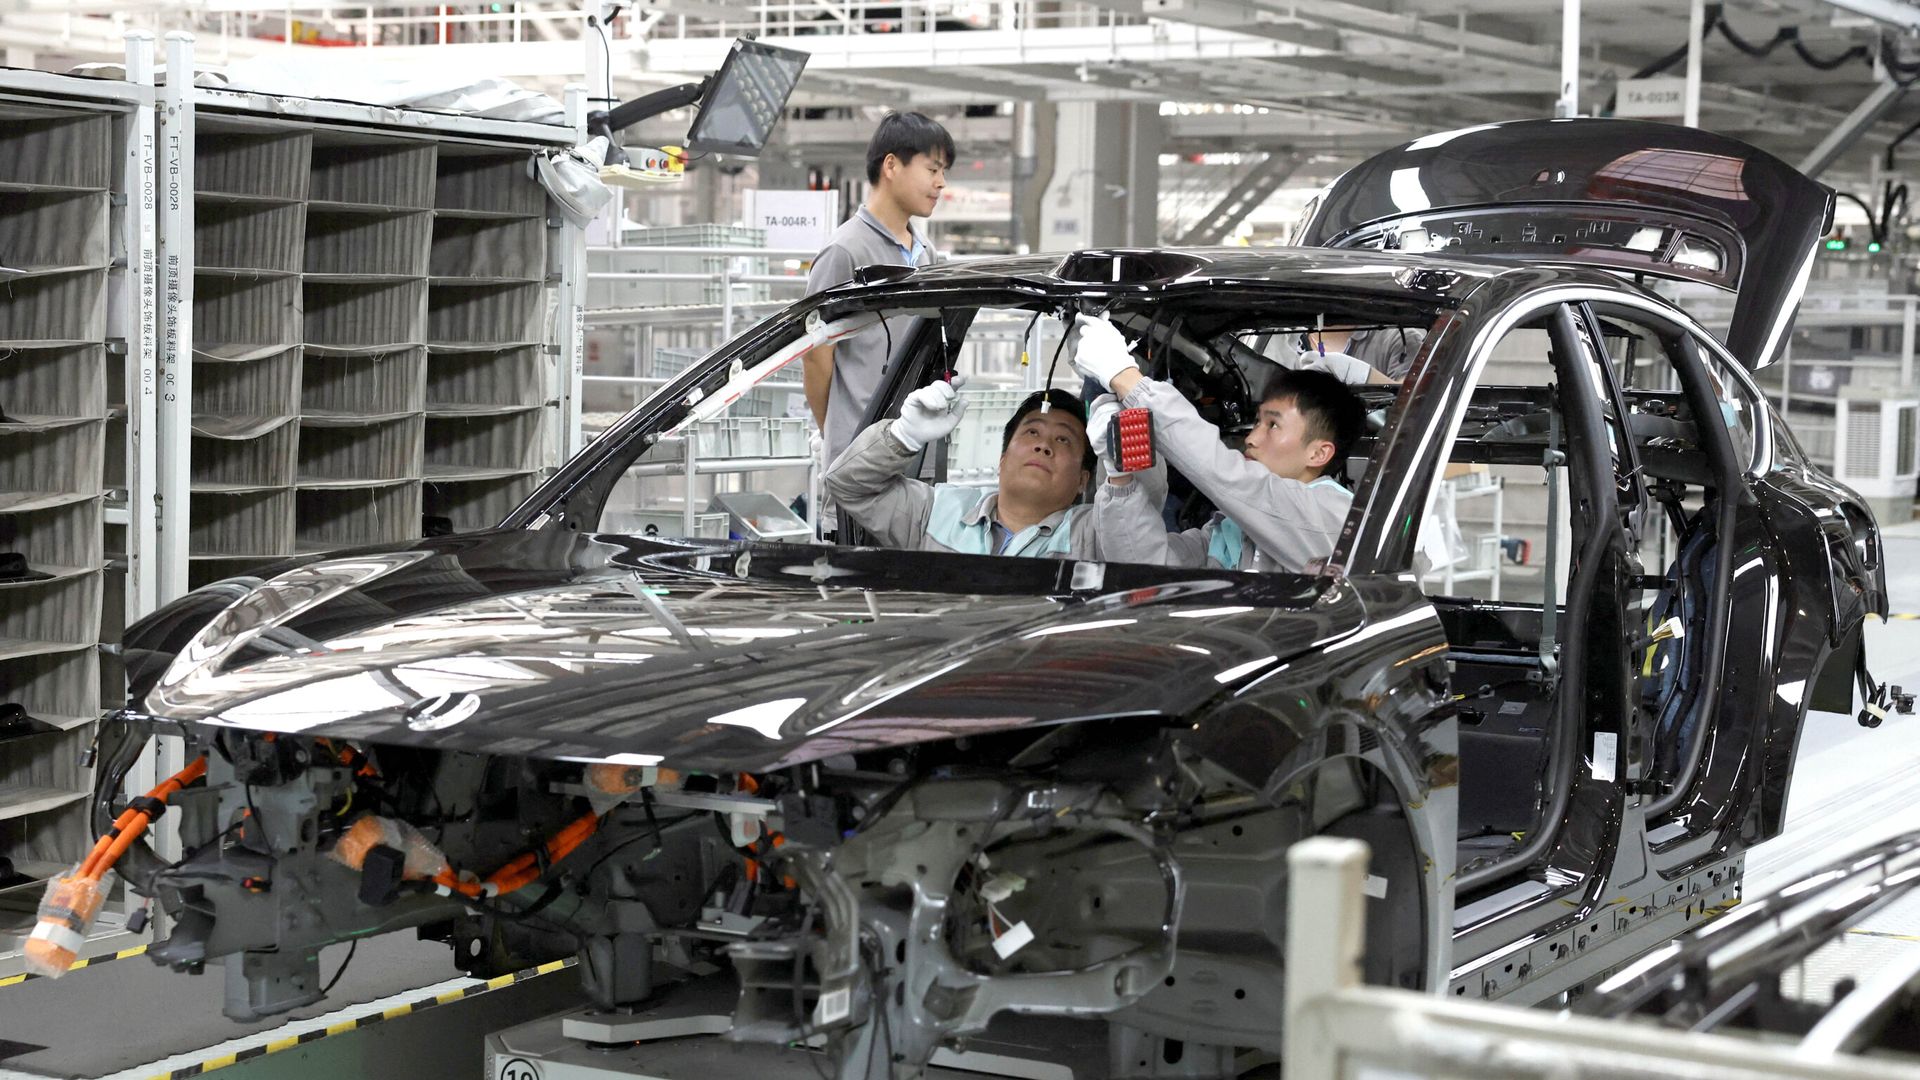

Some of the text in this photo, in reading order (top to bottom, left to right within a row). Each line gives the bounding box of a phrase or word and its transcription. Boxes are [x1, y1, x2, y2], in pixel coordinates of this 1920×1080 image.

[143, 134, 153, 210] FT-VB-0028
[169, 135, 179, 211] FT-VB-0028
[764, 215, 817, 227] TA-004R-1
[143, 248, 153, 360] 前顶摄像头饰板料架
[166, 254, 179, 364] 前顶摄像头饰板料架
